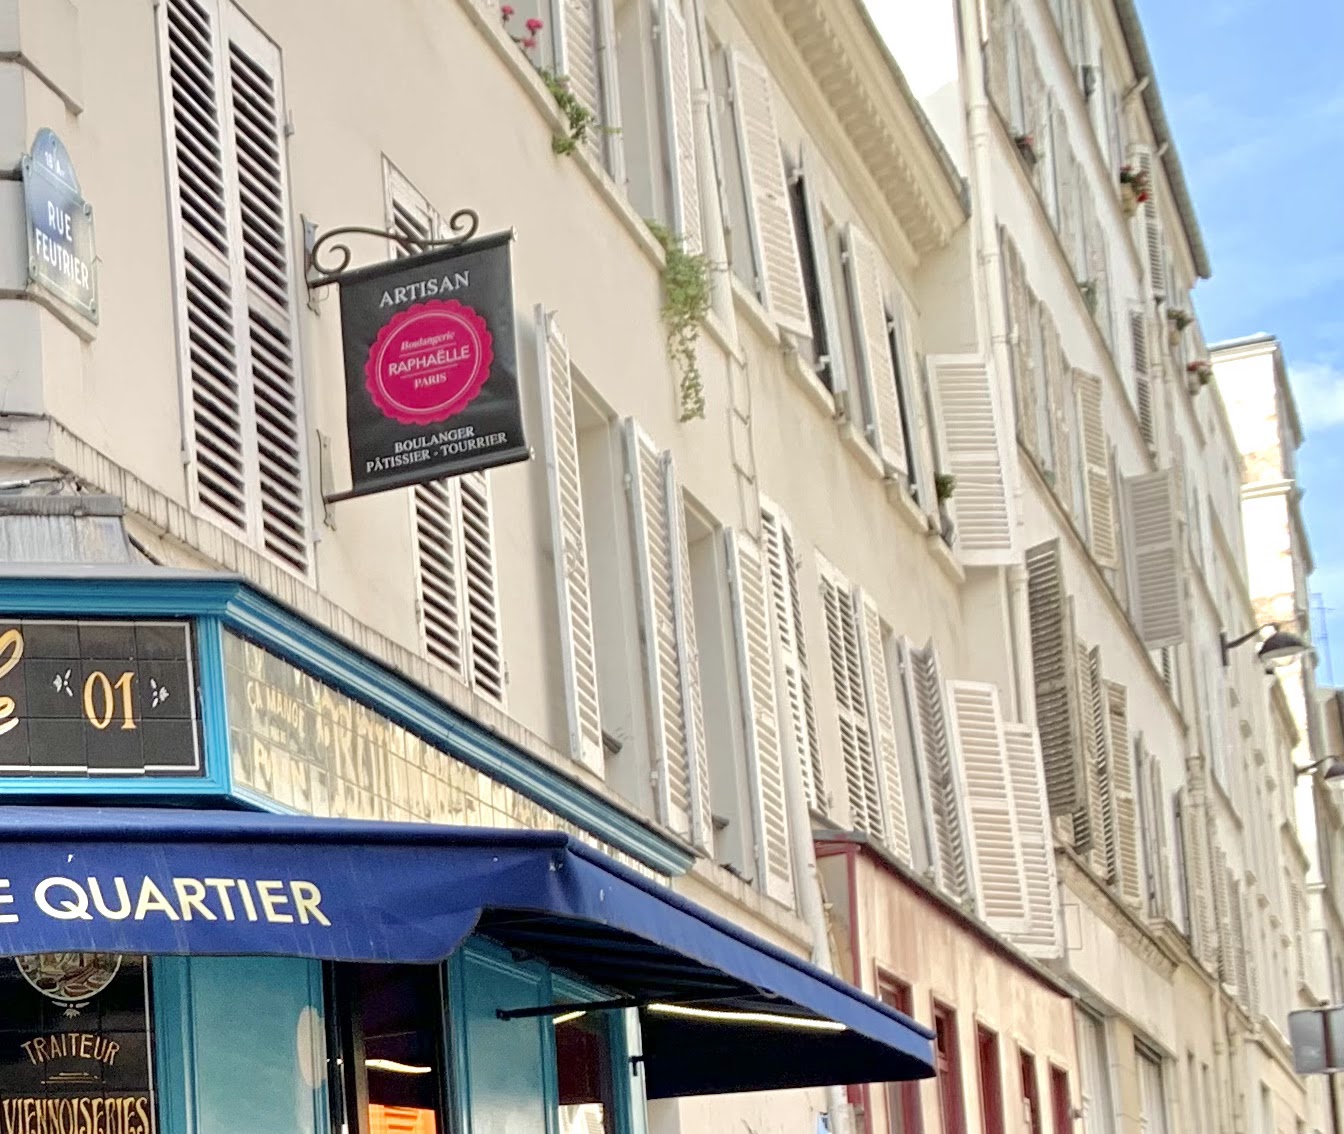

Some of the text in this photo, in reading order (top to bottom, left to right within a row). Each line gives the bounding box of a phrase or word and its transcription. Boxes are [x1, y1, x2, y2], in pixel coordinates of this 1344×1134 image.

[47, 200, 73, 242] RUE
[35, 227, 89, 290] FEUTRIER
[379, 270, 470, 308] ARTISAN
[401, 331, 455, 351] Boulangerie
[388, 345, 470, 376] RAPHAËLLE
[414, 372, 447, 389] PARIS
[366, 449, 431, 473] PÂTISSIER
[440, 432, 508, 457] TOURRIER
[394, 426, 475, 454] BOULANGER
[83, 669, 138, 731] 01
[34, 875, 332, 928] QUARTIER
[20, 1032, 120, 1066] TRAITEUR
